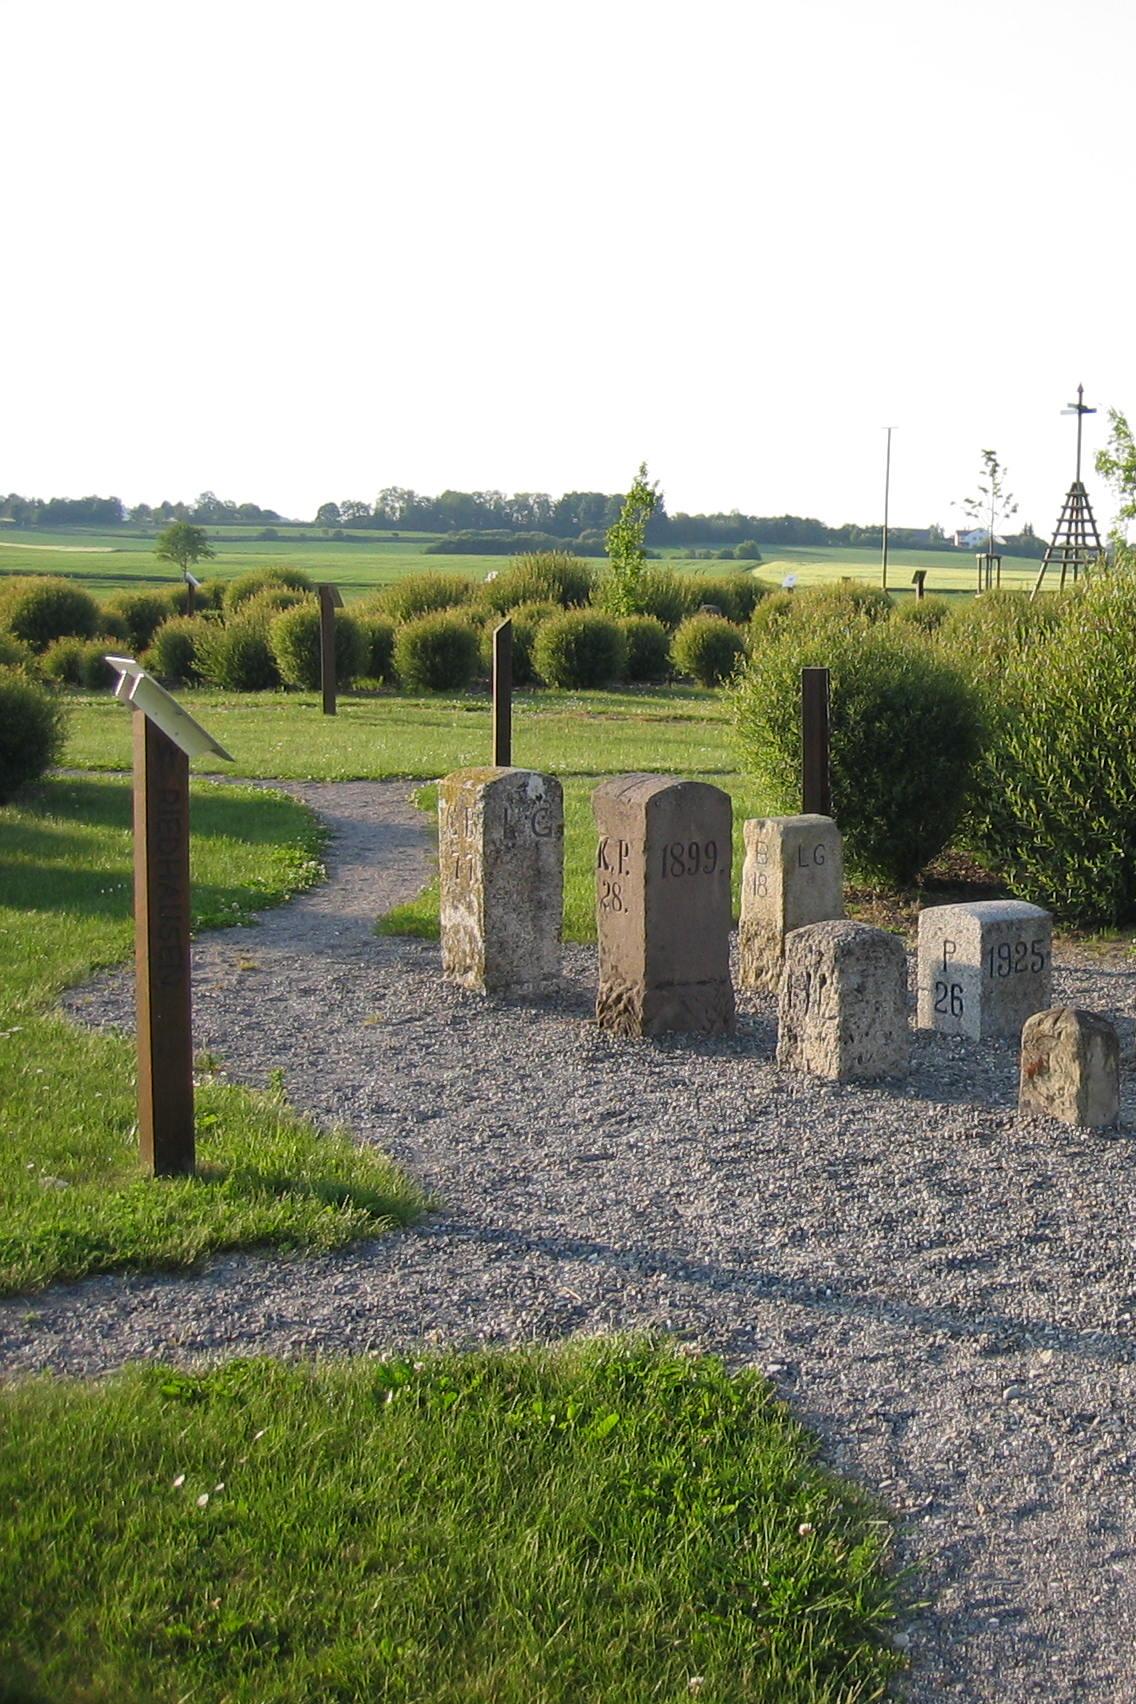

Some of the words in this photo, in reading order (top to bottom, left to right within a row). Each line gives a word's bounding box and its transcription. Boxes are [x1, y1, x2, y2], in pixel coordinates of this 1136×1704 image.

[752, 872, 768, 898] 18
[943, 940, 957, 973] P
[987, 940, 1045, 979] 1925
[934, 981, 964, 1019] 26
